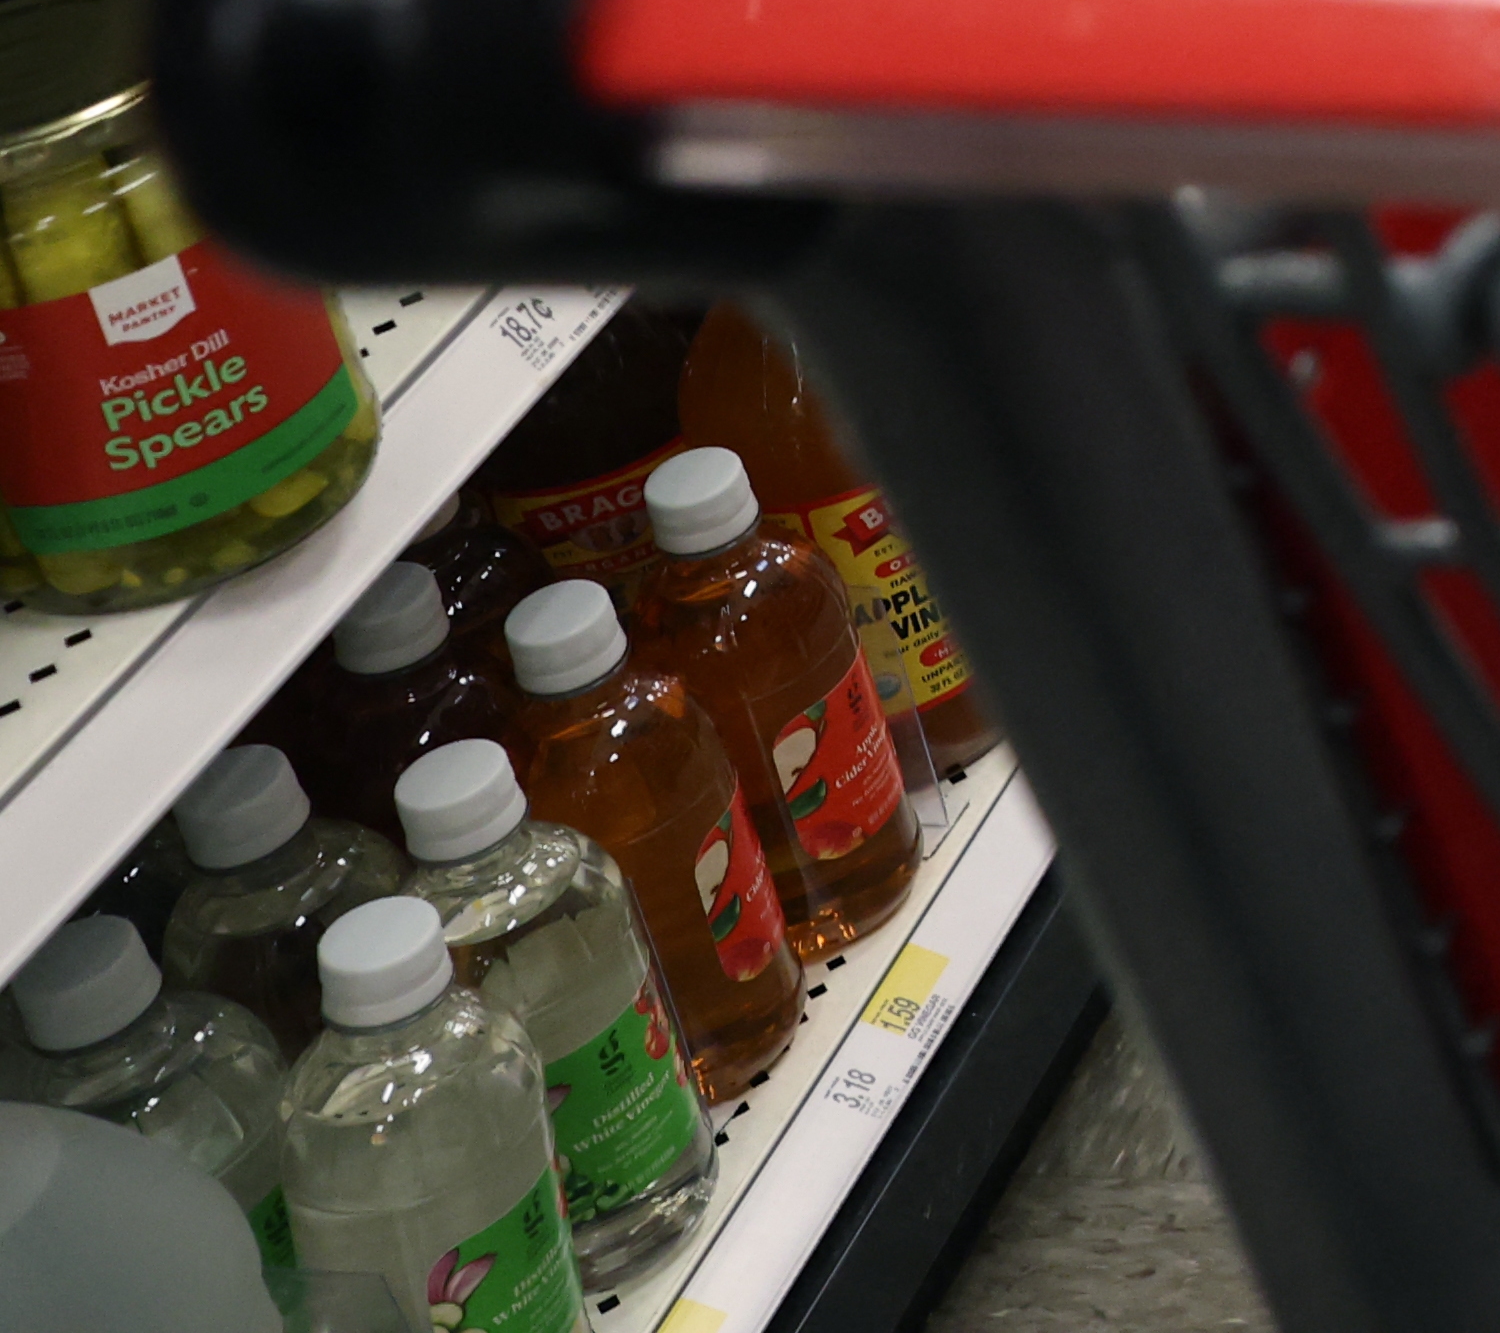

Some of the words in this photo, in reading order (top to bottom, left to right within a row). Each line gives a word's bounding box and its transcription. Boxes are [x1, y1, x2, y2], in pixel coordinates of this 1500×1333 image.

[107, 284, 184, 332] MARKET
[98, 342, 186, 397] Kosher
[188, 326, 232, 369] Dill
[101, 352, 248, 433] Pickle
[104, 384, 269, 473] Spears
[834, 760, 869, 790] Cider
[876, 995, 921, 1035] 1.59
[592, 1071, 656, 1127] Distilled
[832, 1068, 876, 1111] 3.18
[573, 1115, 626, 1154] White
